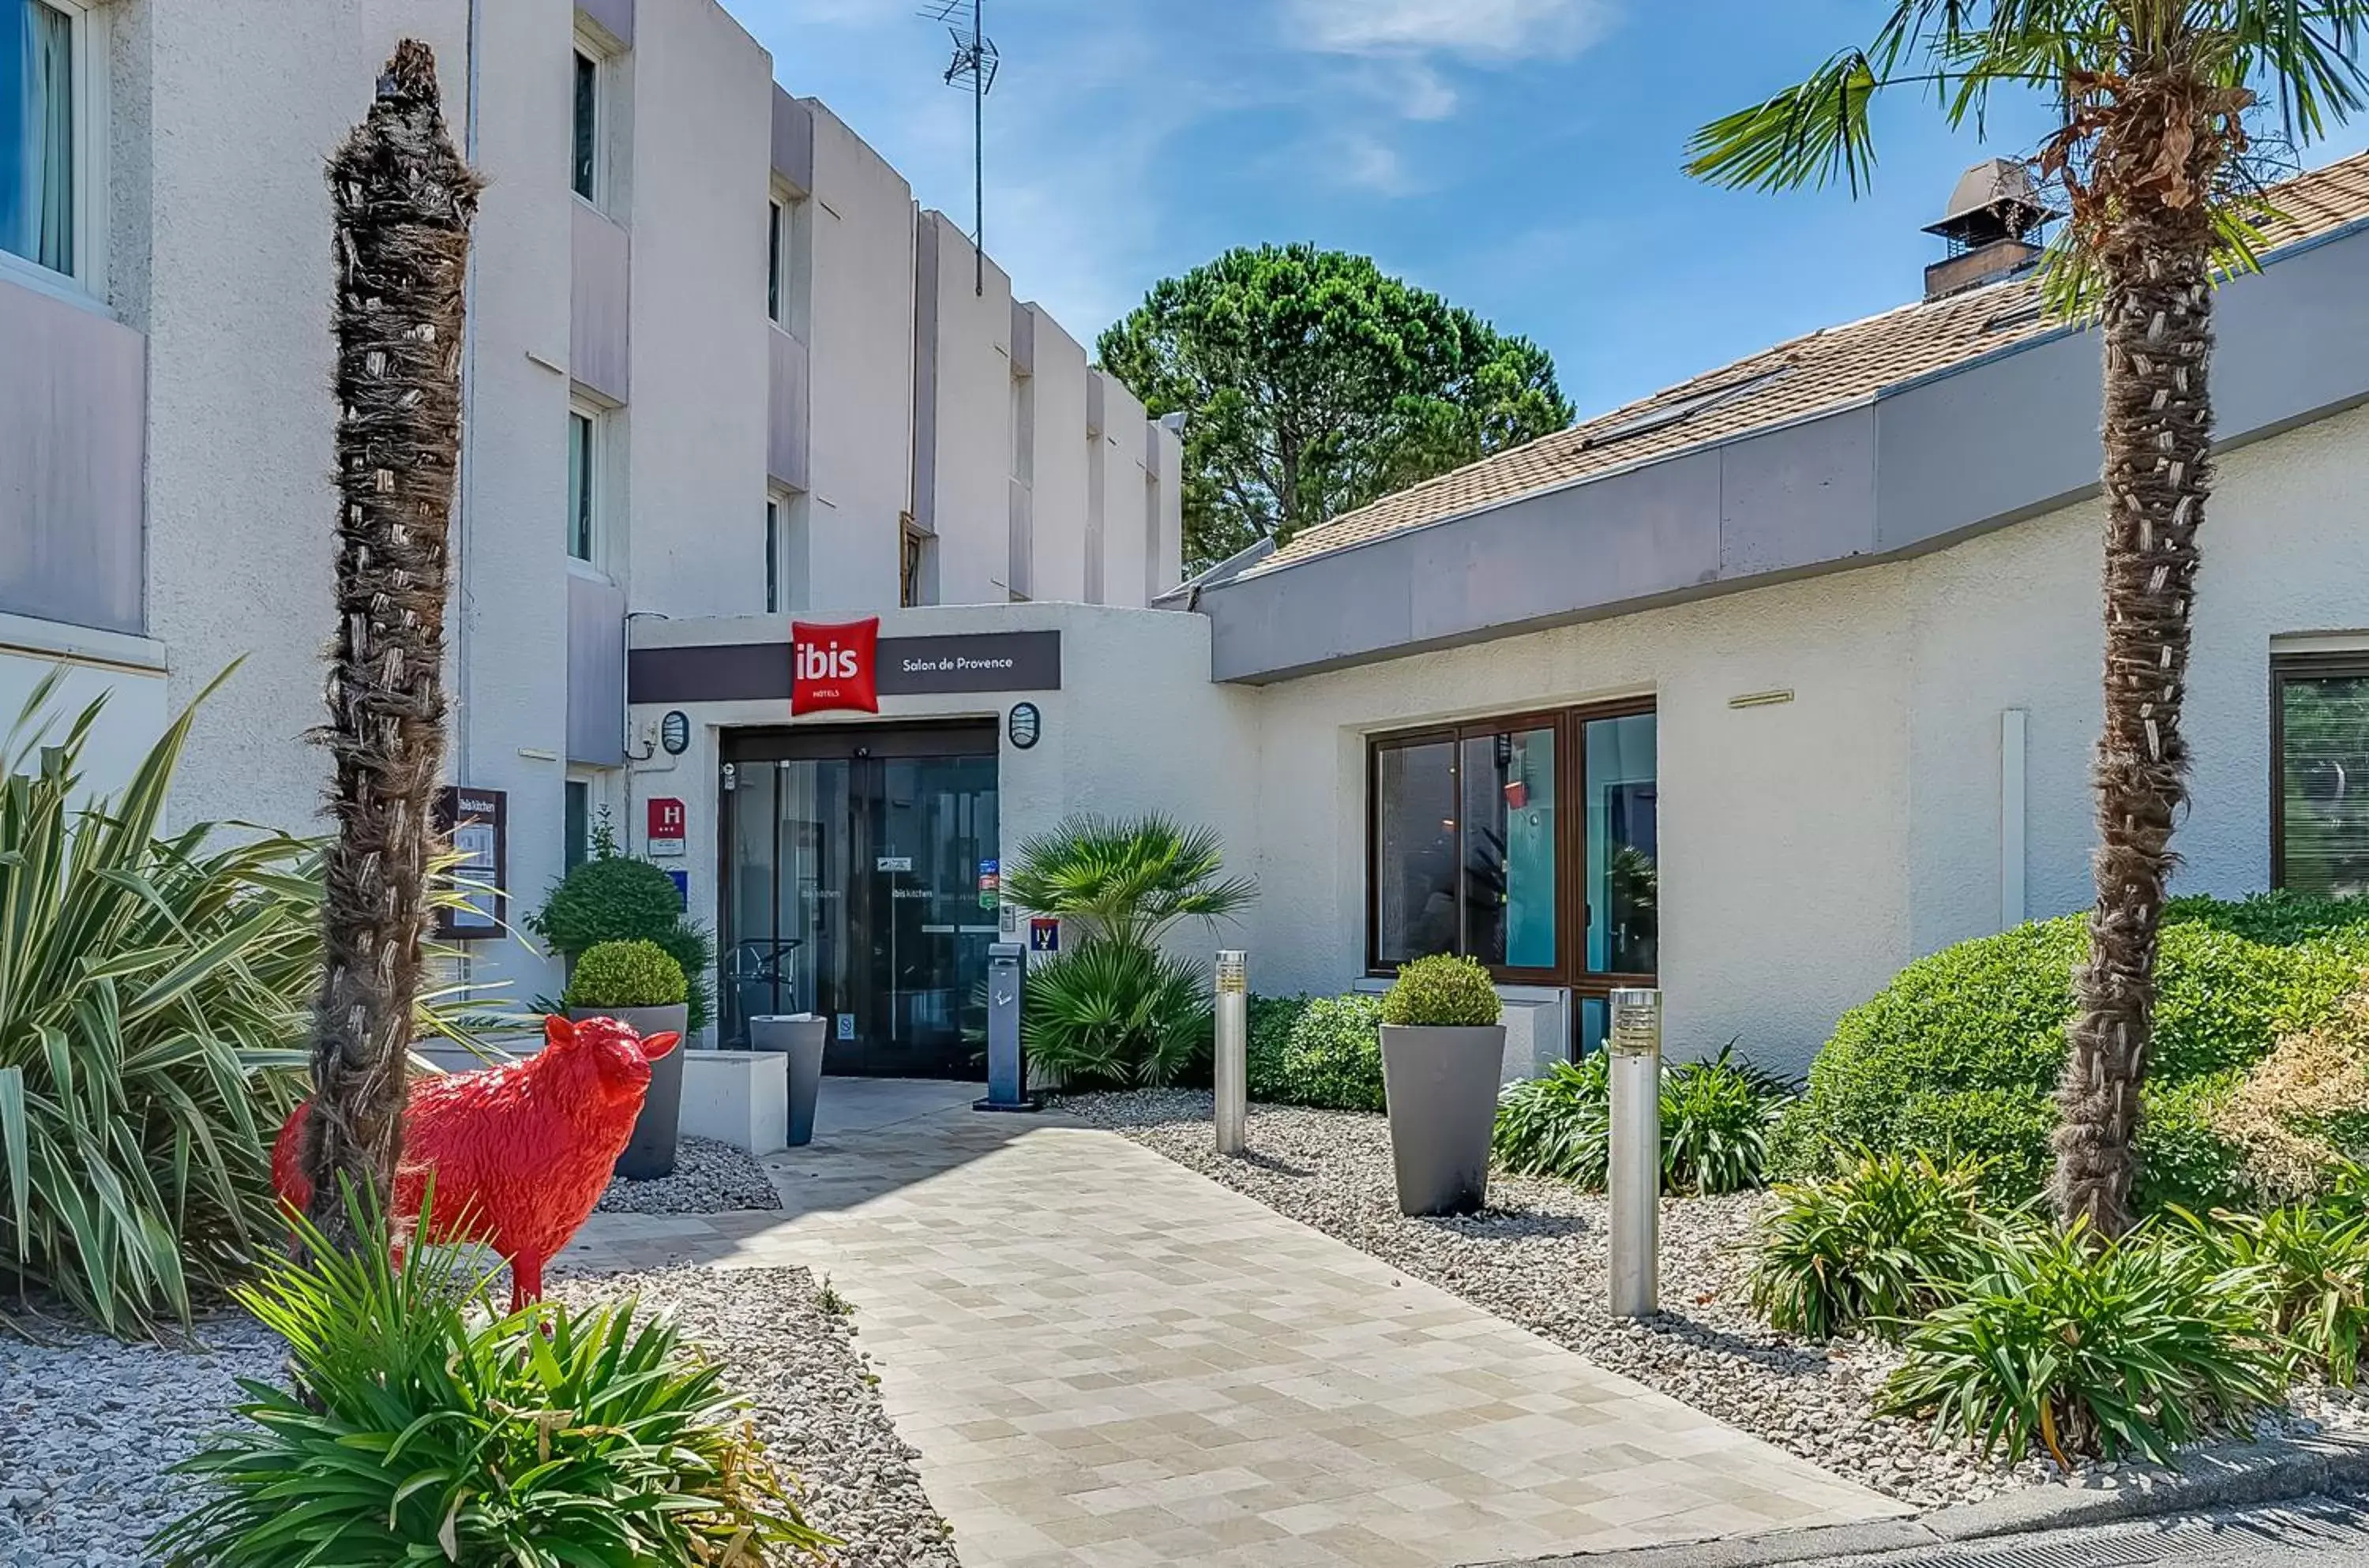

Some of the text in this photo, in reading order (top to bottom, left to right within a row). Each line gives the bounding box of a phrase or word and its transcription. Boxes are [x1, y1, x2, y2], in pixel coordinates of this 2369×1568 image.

[797, 641, 858, 680] ibis
[903, 657, 1013, 671] Salon de Provence
[813, 689, 839, 698] HOTELS
[664, 806, 680, 823] H
